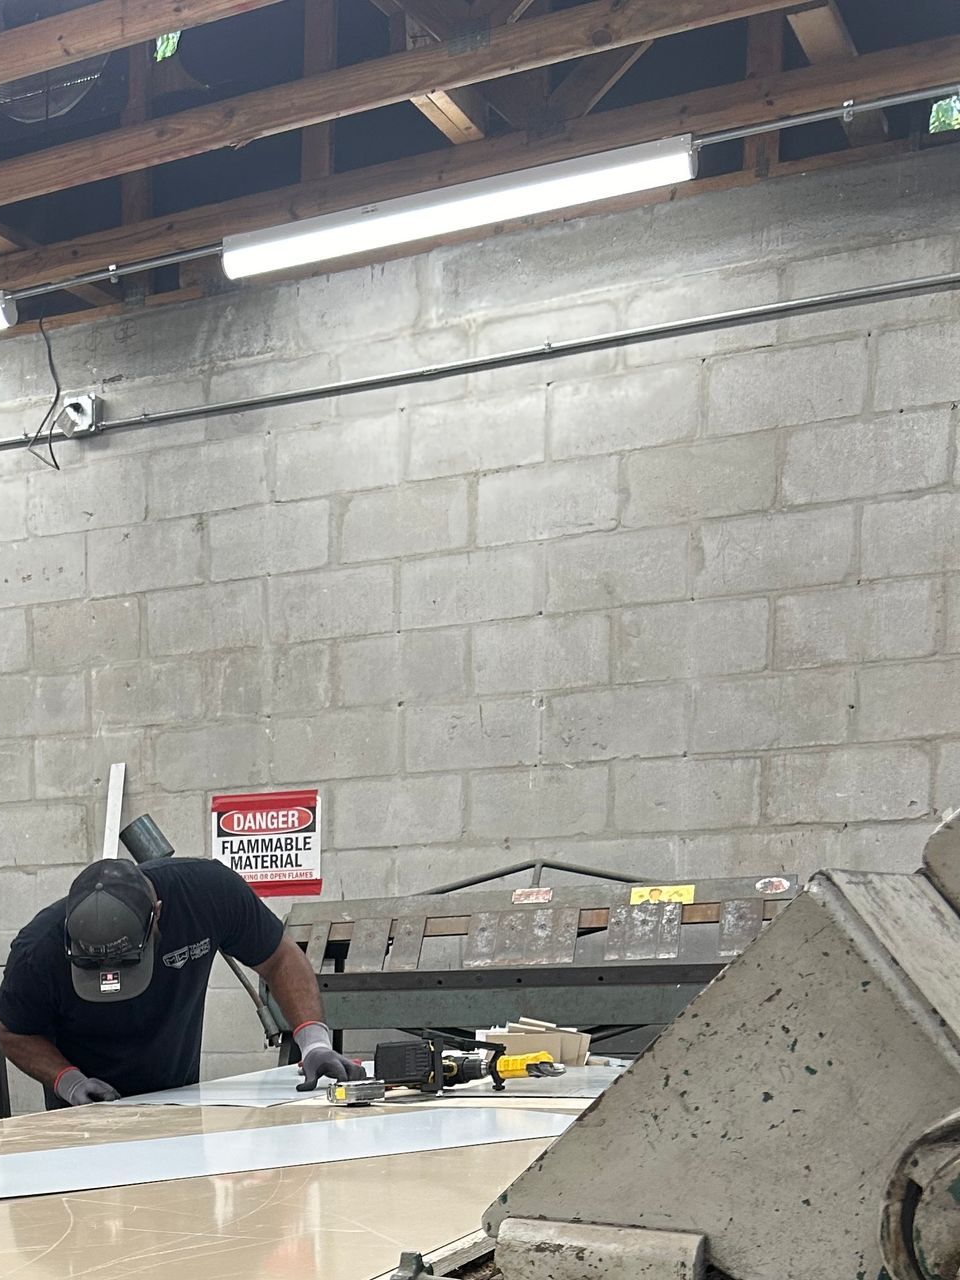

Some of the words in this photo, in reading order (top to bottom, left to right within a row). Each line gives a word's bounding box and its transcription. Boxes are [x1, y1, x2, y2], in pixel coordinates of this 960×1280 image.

[233, 810, 299, 831] DANGER
[221, 836, 312, 855] FLAMMABLE
[230, 853, 303, 871] MATERIAL
[270, 872, 287, 880] OPEN
[288, 871, 314, 879] FLAMES
